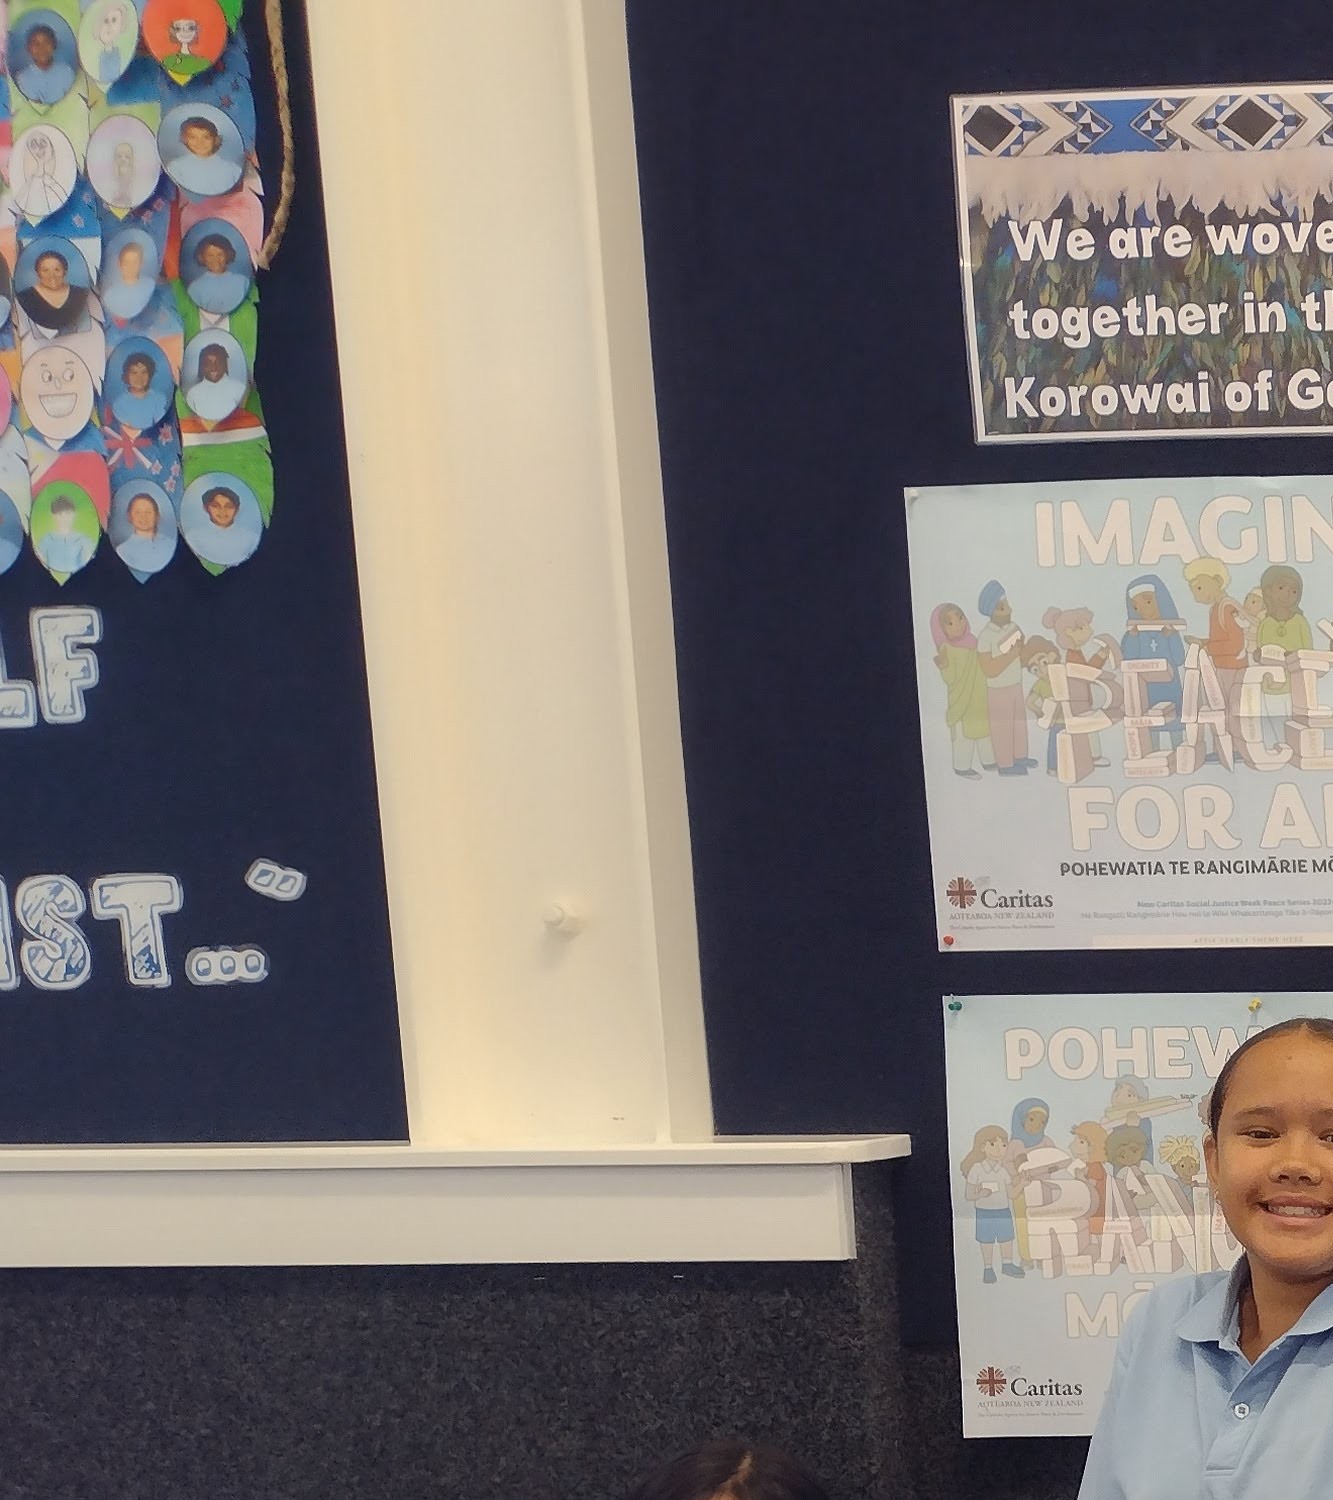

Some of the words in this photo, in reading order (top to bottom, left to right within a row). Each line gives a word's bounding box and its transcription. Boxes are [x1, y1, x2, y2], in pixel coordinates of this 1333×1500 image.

[1007, 218, 1096, 262] We
[1109, 222, 1193, 260] are
[1008, 294, 1229, 349] together
[1244, 292, 1287, 334] in
[1004, 371, 1211, 419] Korowai
[1224, 368, 1272, 412] of
[1066, 785, 1242, 852] FOR
[1060, 860, 1166, 877] POHEWATIA
[1169, 861, 1190, 875] TE
[1194, 856, 1308, 876] RANGIMĀRIE
[980, 888, 1054, 909] Caritas
[1010, 1377, 1084, 1397] Caritas
